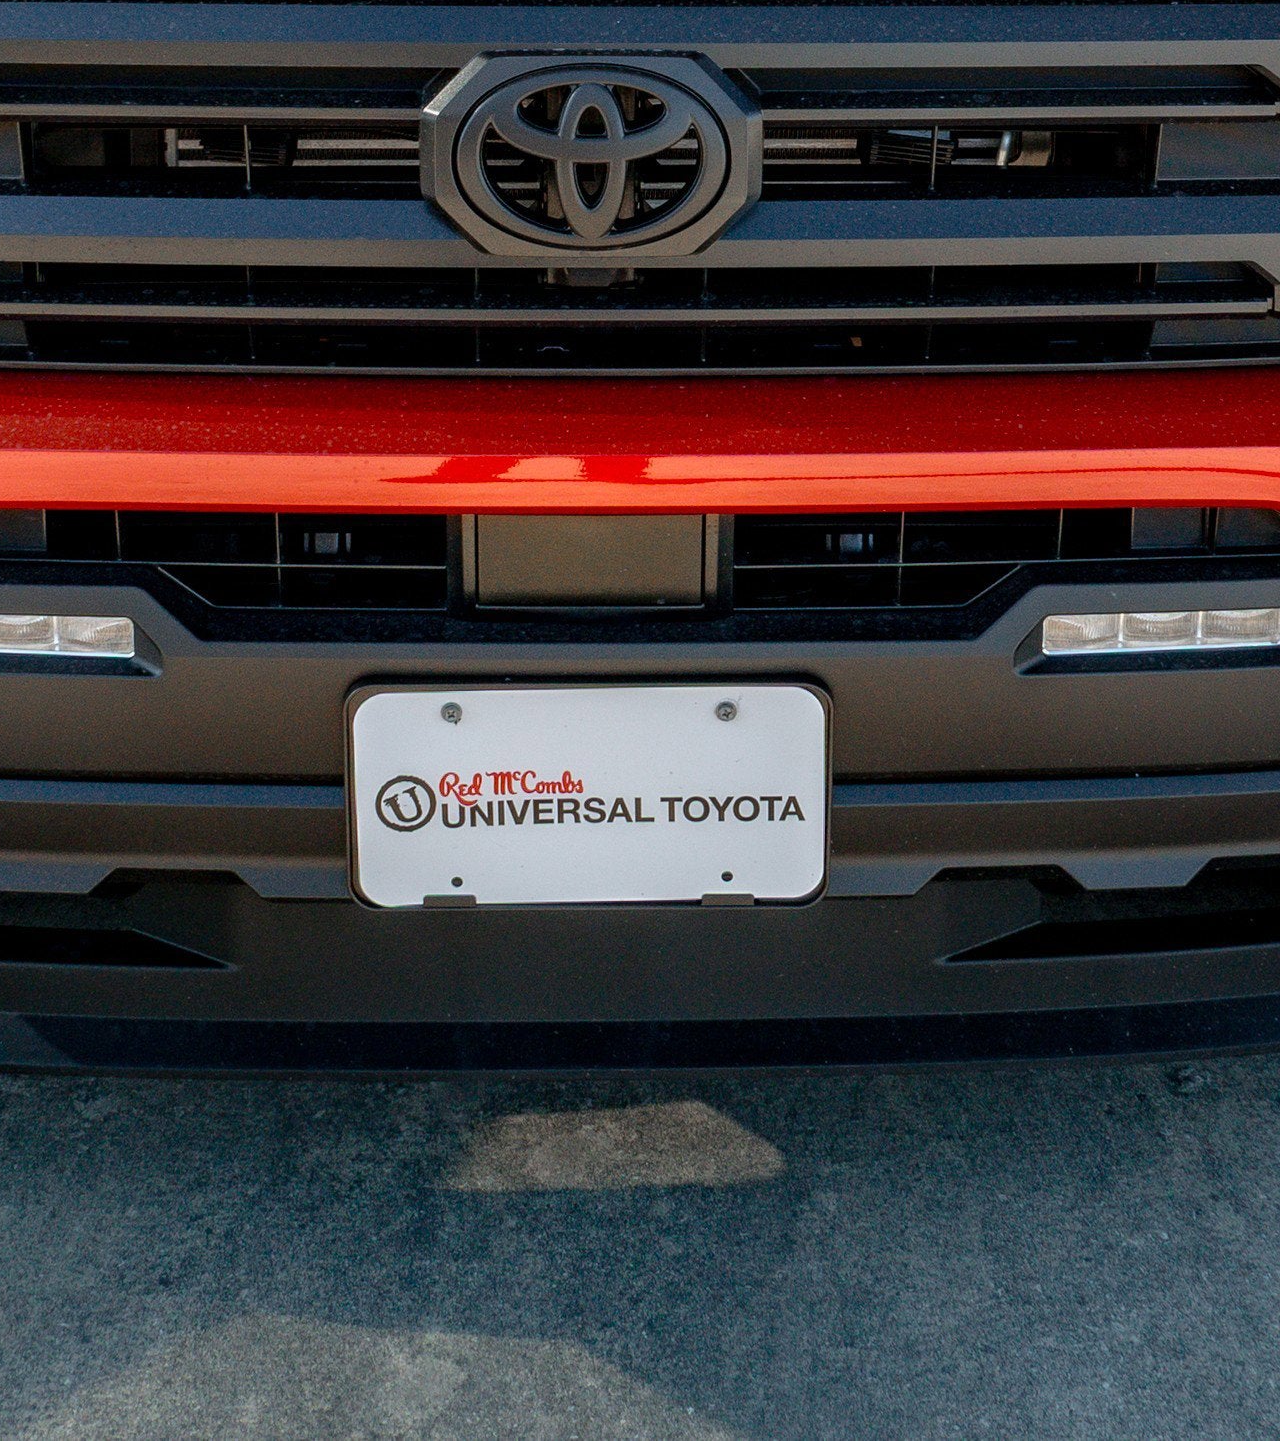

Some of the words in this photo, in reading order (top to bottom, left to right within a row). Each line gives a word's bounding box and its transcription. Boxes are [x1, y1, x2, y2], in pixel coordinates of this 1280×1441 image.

[439, 772, 483, 806] Red
[486, 770, 584, 794] McCombs
[441, 797, 655, 829] UNIVERSAL
[660, 795, 806, 823] TOYOTA
